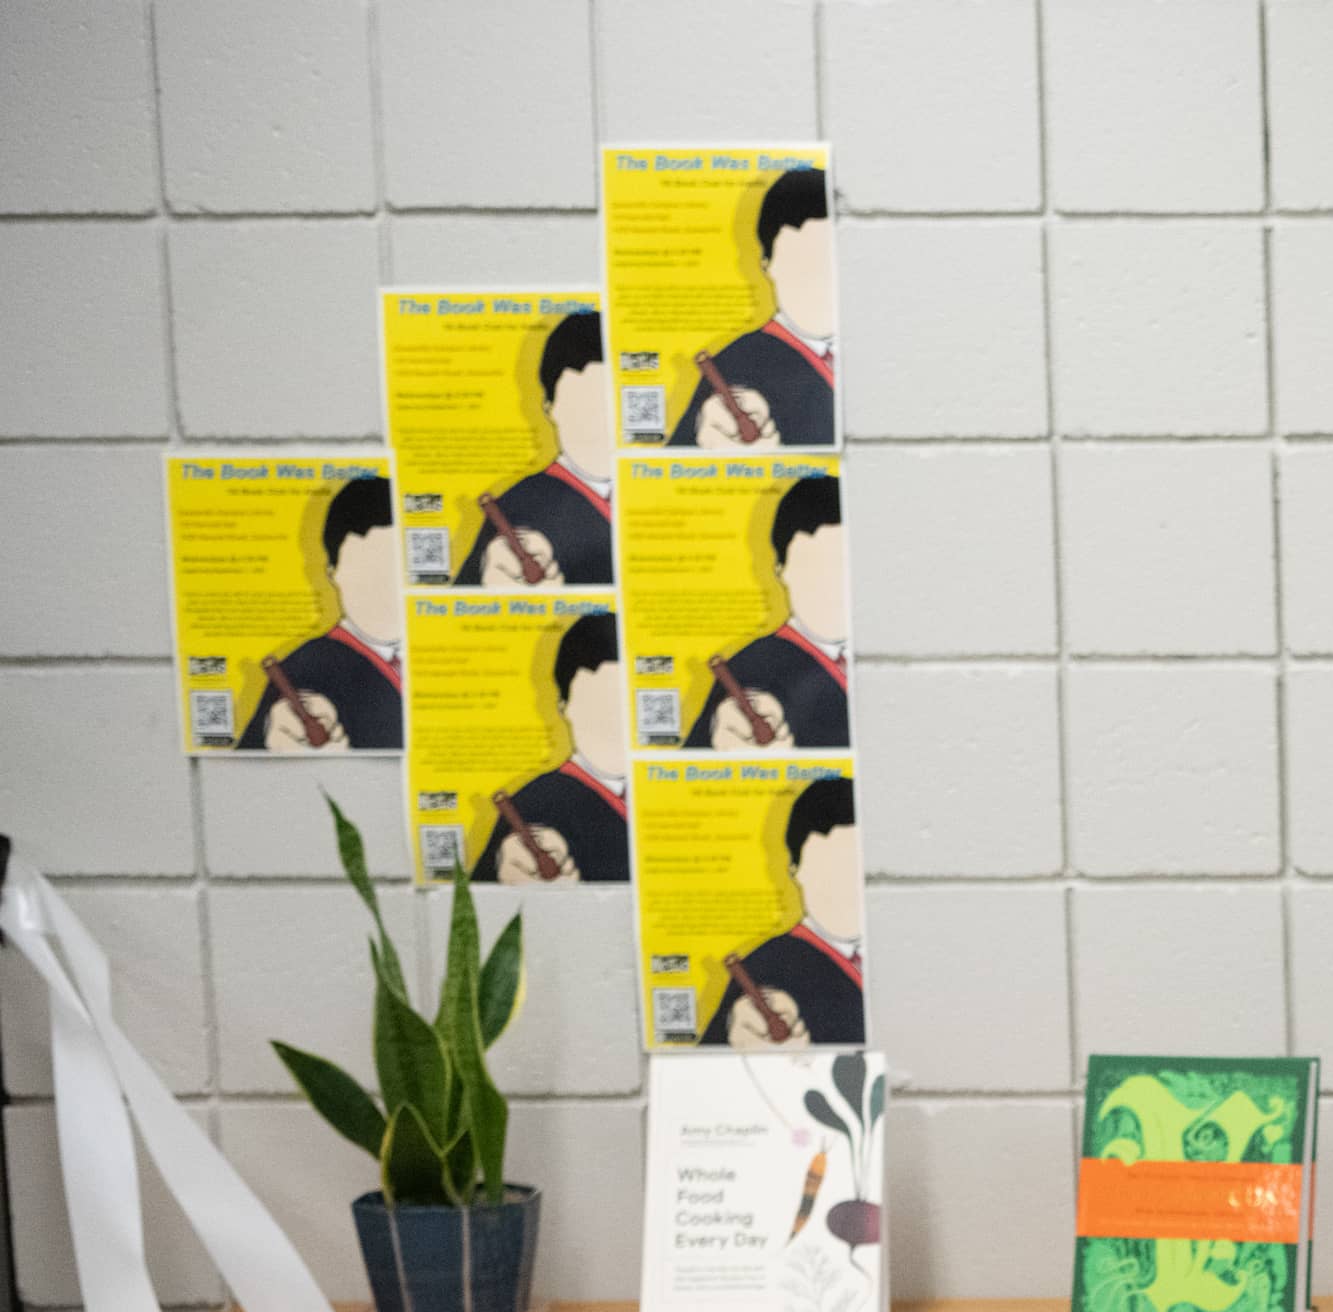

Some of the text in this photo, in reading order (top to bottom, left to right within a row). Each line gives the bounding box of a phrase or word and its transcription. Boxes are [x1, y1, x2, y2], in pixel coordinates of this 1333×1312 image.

[616, 155, 815, 171] The Book Was Better
[399, 299, 595, 315] The Book Was Better
[182, 464, 379, 479] The Book Was Better
[631, 463, 828, 478] The Book Was Better
[415, 600, 610, 615] The Book Was Better
[648, 765, 842, 781] The Book Was Better
[677, 1167, 736, 1182] Whole
[677, 1188, 724, 1205] Food
[675, 1210, 753, 1229] Cooking
[675, 1232, 768, 1250] Every Day
